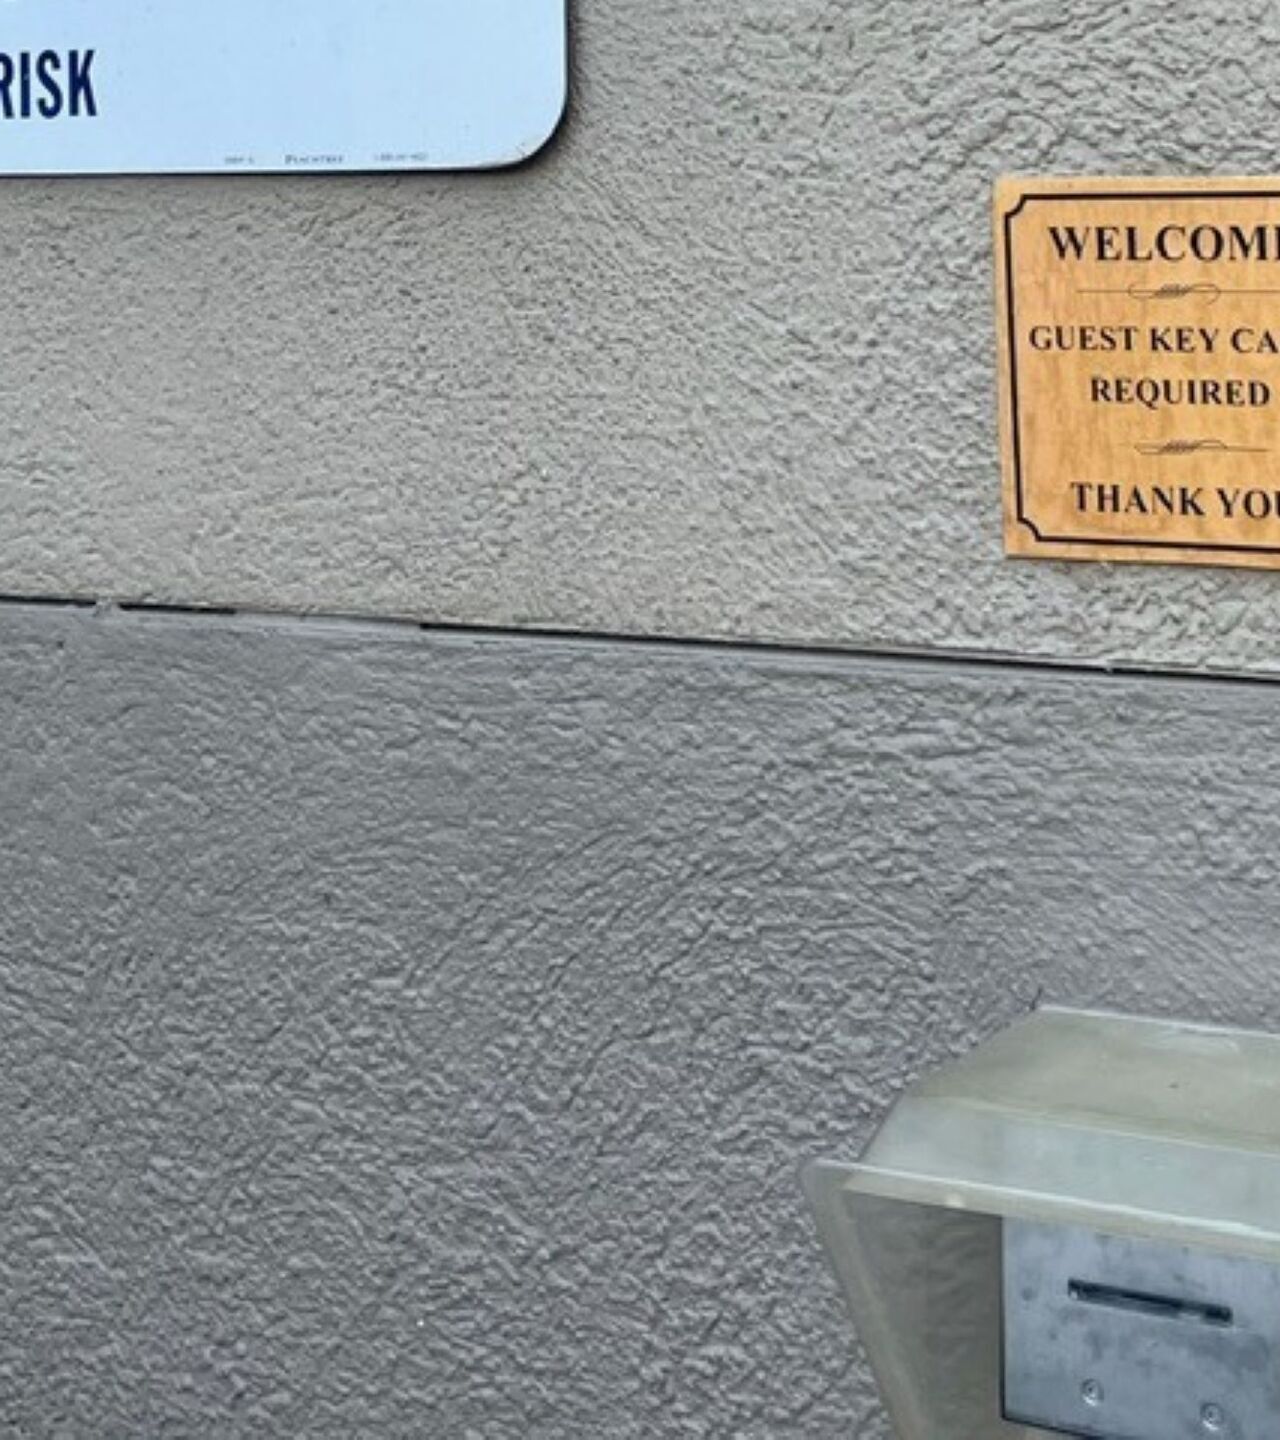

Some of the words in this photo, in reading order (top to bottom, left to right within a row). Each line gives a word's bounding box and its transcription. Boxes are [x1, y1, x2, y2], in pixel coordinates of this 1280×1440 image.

[1028, 325, 1139, 353] GUEST
[1150, 327, 1220, 355] KEY
[1090, 376, 1272, 412] REQUIRED
[1070, 481, 1205, 518] THANK
